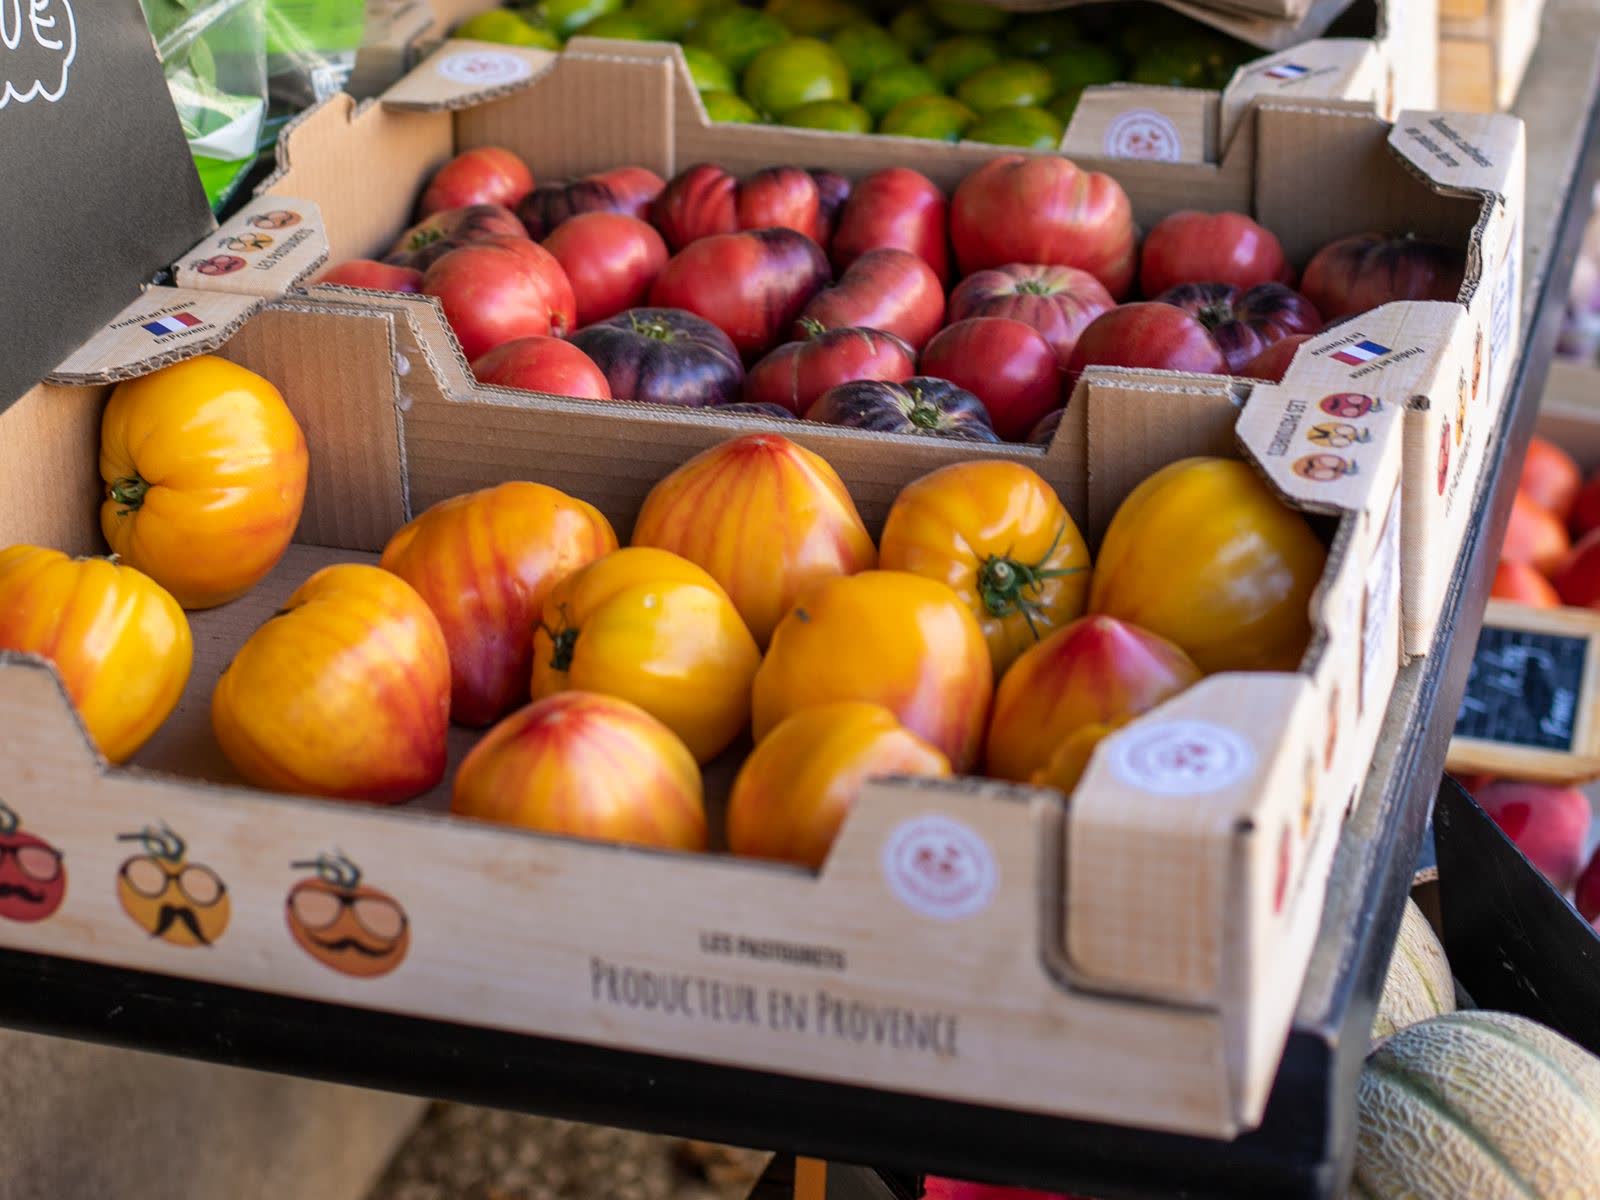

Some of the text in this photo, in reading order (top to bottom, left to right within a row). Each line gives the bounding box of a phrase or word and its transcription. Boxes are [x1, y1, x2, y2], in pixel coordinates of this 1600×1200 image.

[109, 301, 197, 330] Produit en France
[170, 324, 216, 341] Provence
